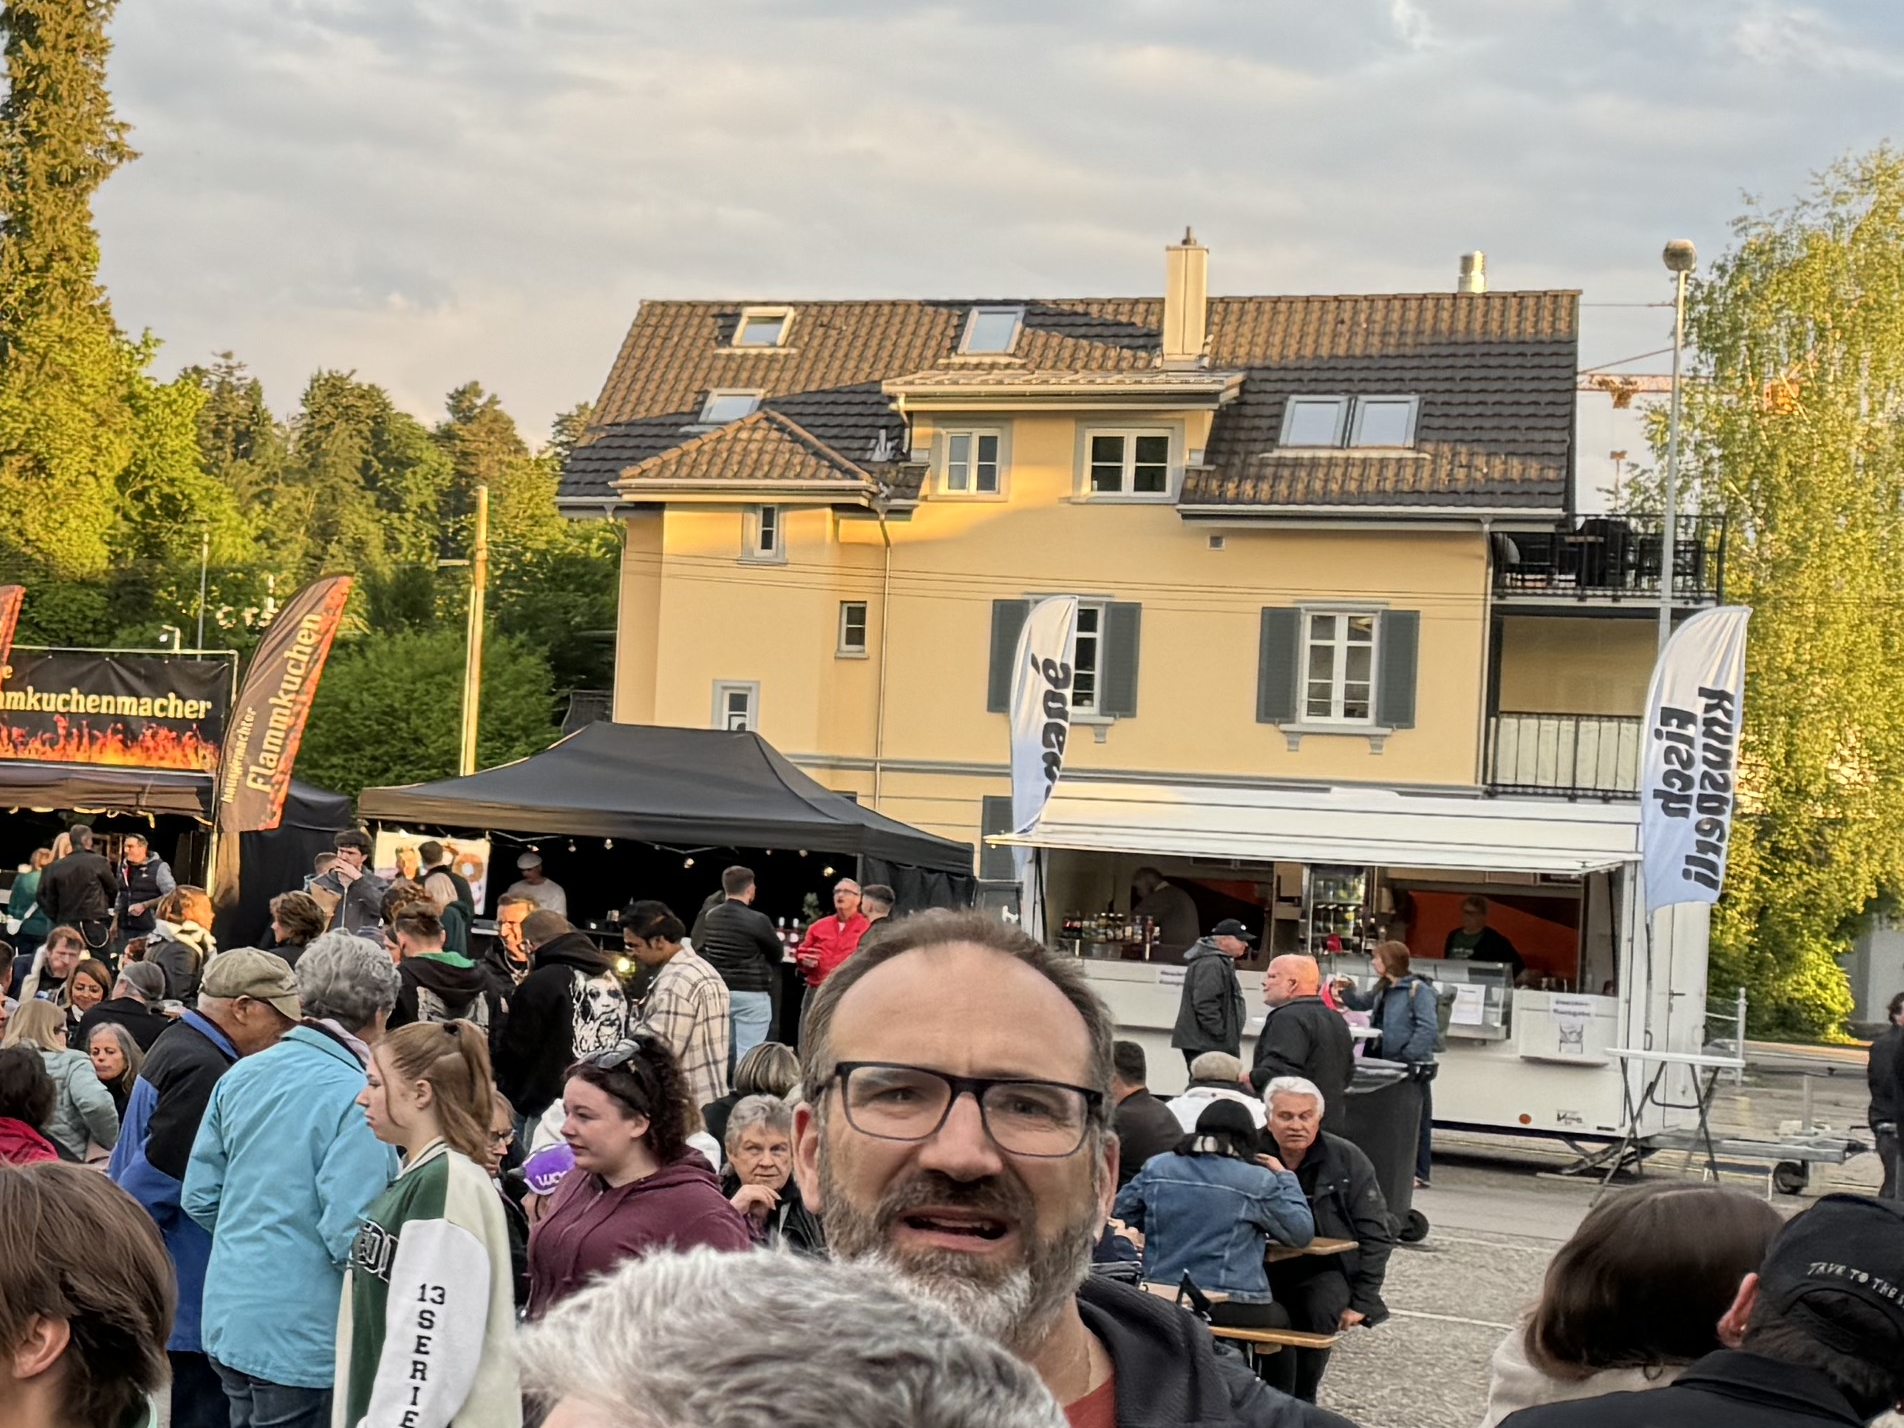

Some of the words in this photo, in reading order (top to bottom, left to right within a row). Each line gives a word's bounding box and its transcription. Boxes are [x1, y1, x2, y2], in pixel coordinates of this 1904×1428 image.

[246, 612, 323, 794] Flammkuchen
[416, 1283, 447, 1306] 13
[1848, 1267, 1870, 1284] TO
[1872, 1277, 1899, 1299] THE
